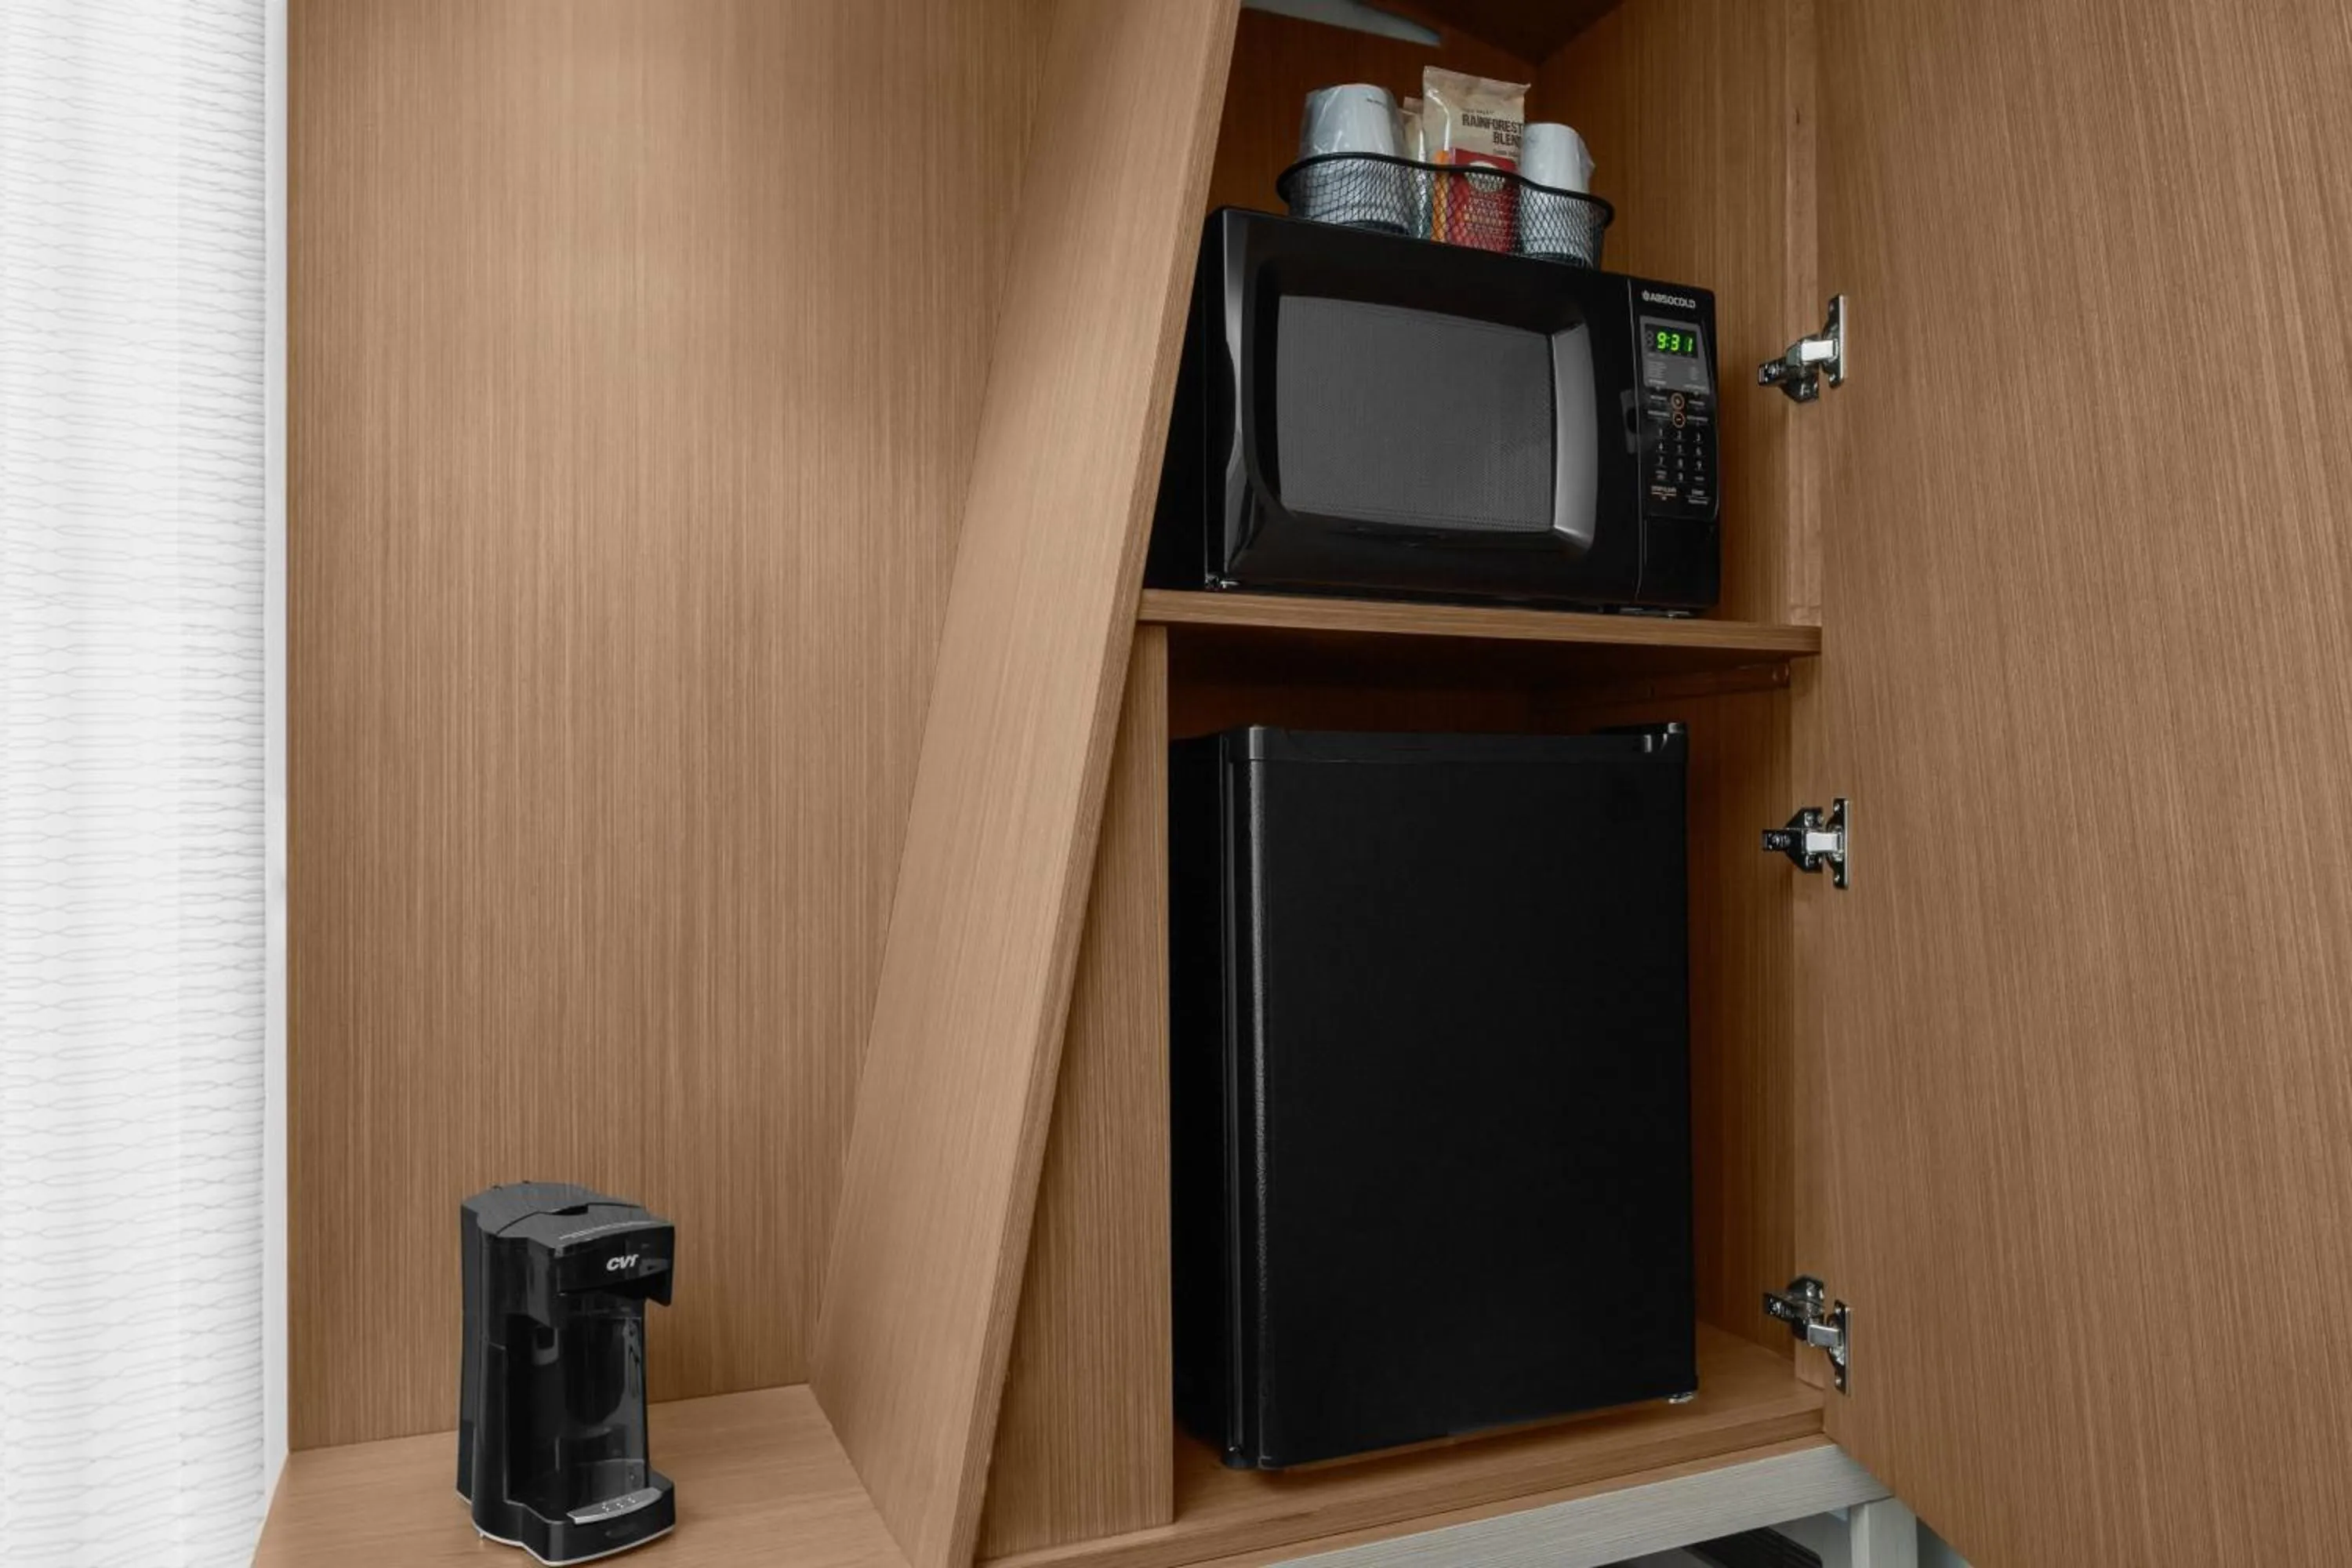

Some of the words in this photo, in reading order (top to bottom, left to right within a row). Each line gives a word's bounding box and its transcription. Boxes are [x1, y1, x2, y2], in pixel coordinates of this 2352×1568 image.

[1461, 113, 1523, 134] RAINFOREST
[1493, 131, 1523, 149] BLEN
[1657, 331, 1693, 352] 9:31
